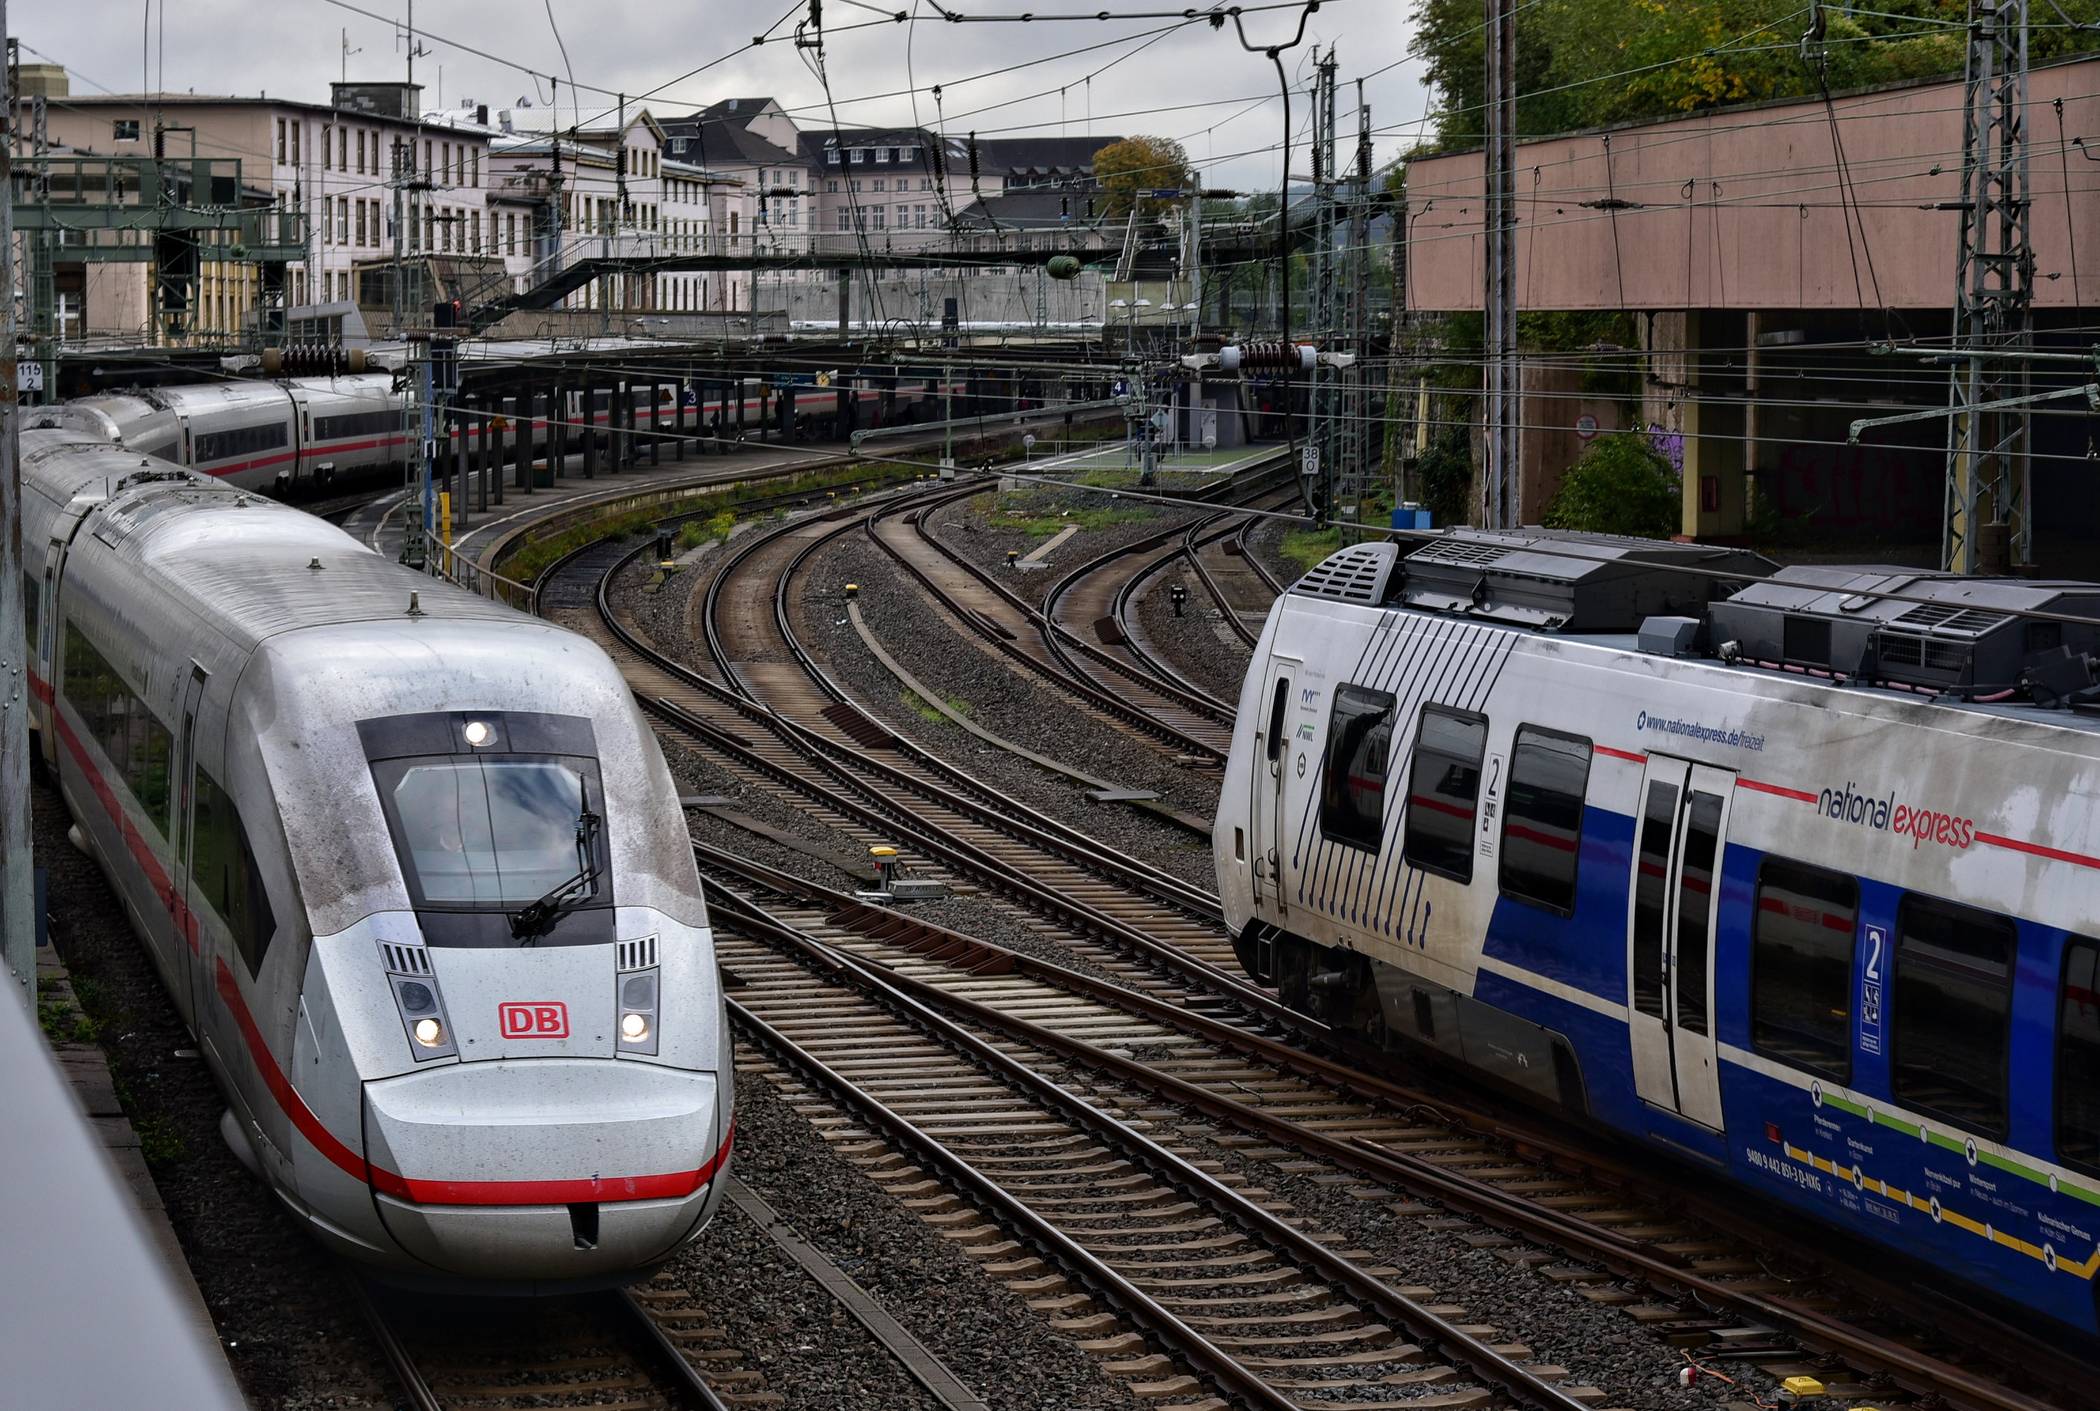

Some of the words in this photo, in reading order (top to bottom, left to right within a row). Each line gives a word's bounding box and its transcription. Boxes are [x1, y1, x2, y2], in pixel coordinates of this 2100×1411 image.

[19, 364, 41, 376] 115
[26, 378, 34, 389] 2
[1114, 381, 1121, 392] 4
[688, 391, 697, 404] 3
[1304, 448, 1318, 460] 38
[1306, 460, 1315, 472] 0
[1646, 715, 1765, 752] www.nationalexpress.de/freizeit
[1488, 758, 1500, 797] 2
[1817, 781, 1895, 831] national
[1893, 804, 1973, 850] express
[1866, 931, 1881, 980] 2
[507, 1007, 561, 1033] DB
[1762, 1154, 1768, 1169] 9
[1768, 1156, 1781, 1175] 442
[1798, 1168, 1822, 1192] D-NXG
